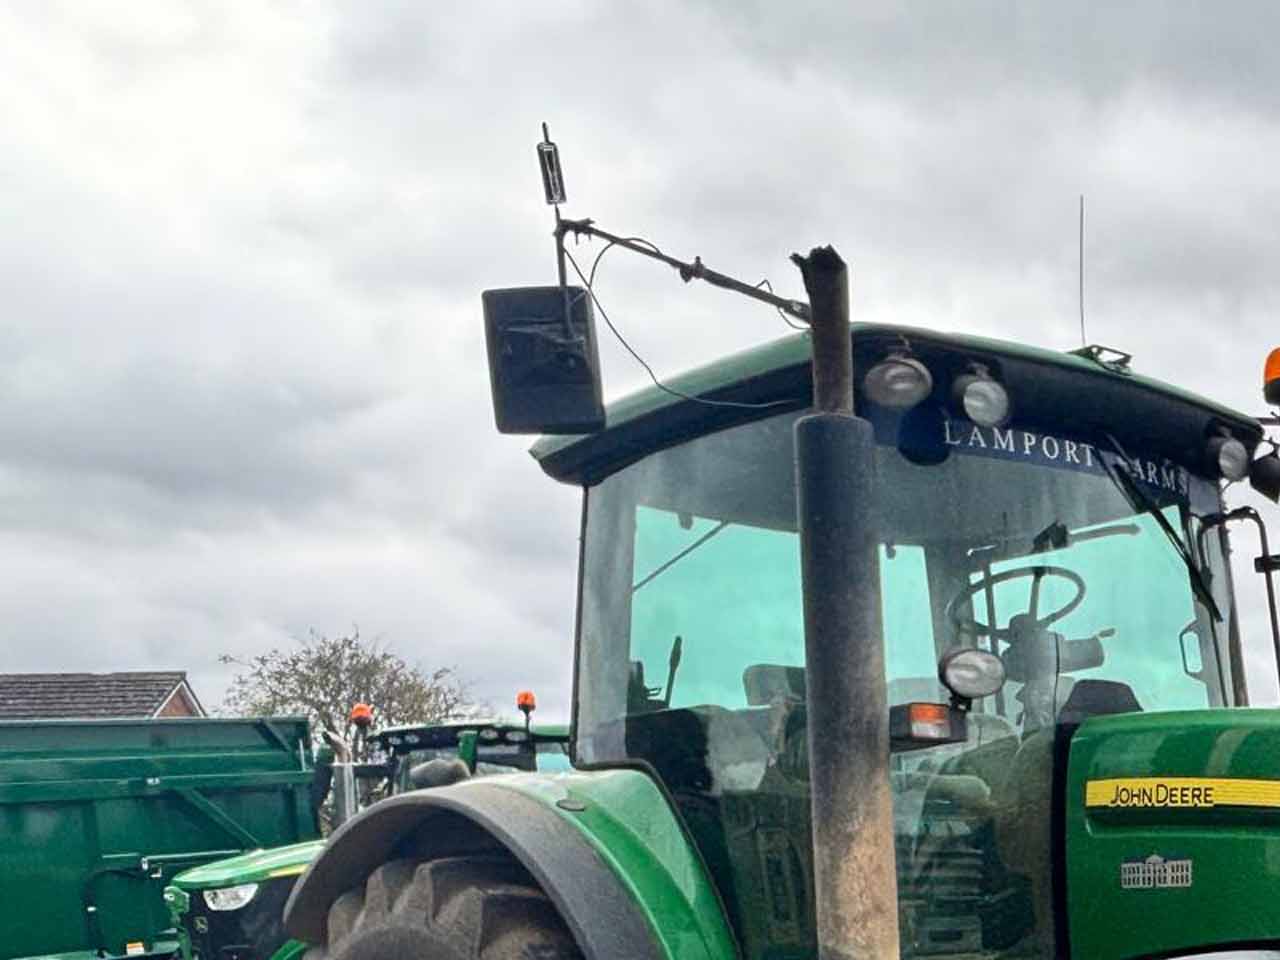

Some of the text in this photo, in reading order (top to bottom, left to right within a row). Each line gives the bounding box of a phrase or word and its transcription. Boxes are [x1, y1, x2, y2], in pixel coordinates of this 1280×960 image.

[943, 420, 1189, 495] LAMPORT ARMS
[1110, 783, 1214, 804] JOHN DEERE
